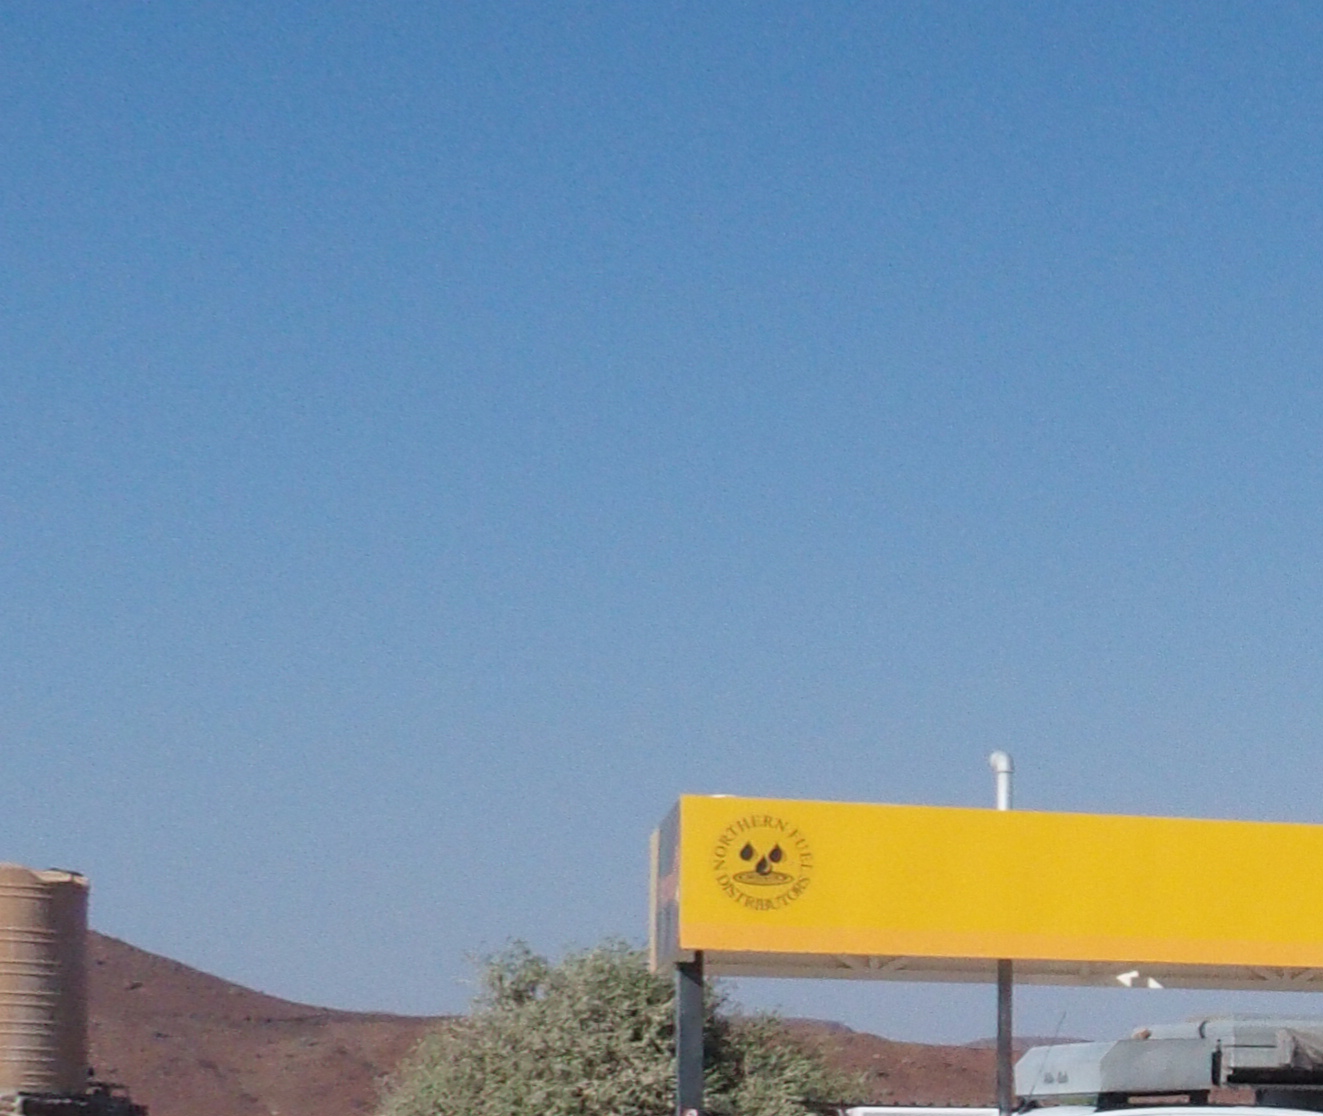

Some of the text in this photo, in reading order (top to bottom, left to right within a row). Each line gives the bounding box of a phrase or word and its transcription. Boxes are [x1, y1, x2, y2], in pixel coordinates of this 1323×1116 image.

[713, 814, 814, 871] NORTHERN FUEL
[715, 874, 811, 911] DISTRIBUTORS
